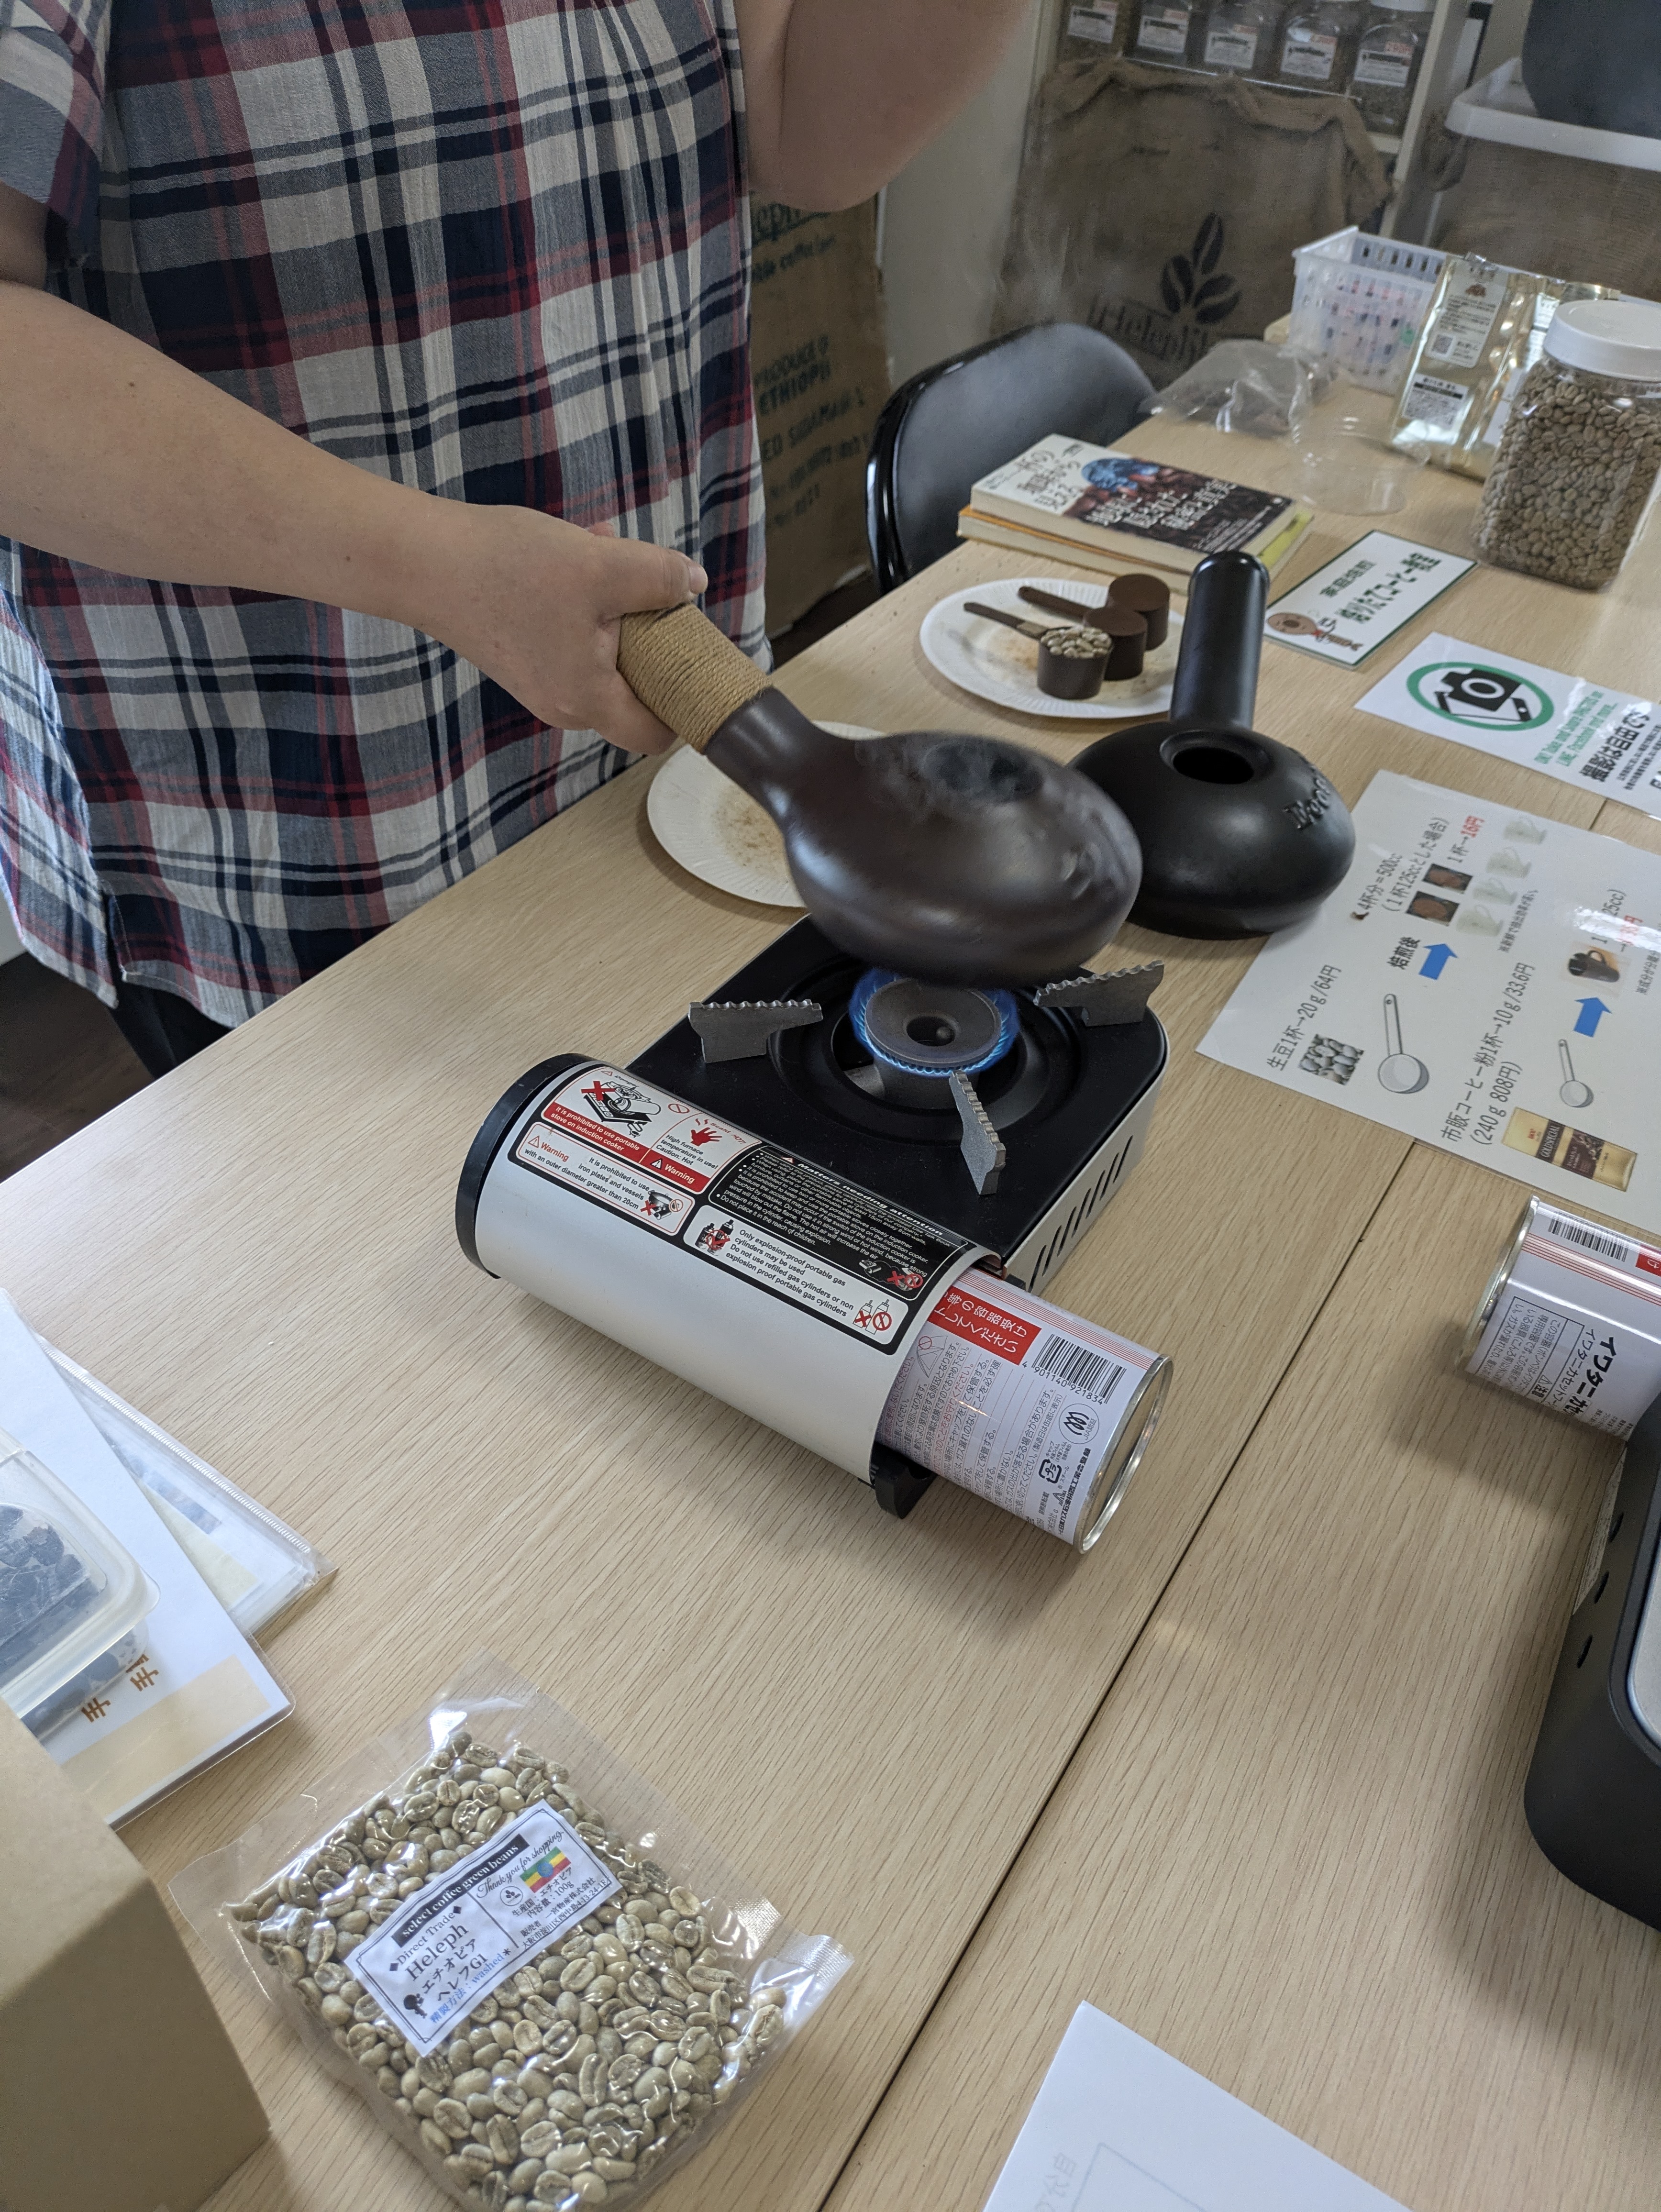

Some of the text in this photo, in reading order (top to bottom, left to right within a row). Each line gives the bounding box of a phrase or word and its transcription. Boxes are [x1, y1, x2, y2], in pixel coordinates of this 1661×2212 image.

[1386, 933, 1421, 971] 焙煎後
[551, 1113, 624, 1150] stove on induction cooker
[566, 1113, 597, 1129] prohibited
[614, 1136, 639, 1150] portable
[665, 1134, 703, 1155] High furnace
[541, 1142, 569, 1162] Warning
[656, 1144, 693, 1165] Caution: Hot
[658, 1139, 696, 1159] temperature
[703, 1161, 719, 1169] use!
[525, 1149, 537, 1158] with
[545, 1160, 561, 1170] outer
[561, 1167, 587, 1182] diameter
[586, 1181, 608, 1193] greater
[608, 1190, 622, 1201] than
[622, 1197, 639, 1209] 20cm
[578, 1163, 644, 1200] iron plates and vessels
[593, 1159, 603, 1167] is
[599, 1164, 631, 1181] prohibited
[638, 1183, 649, 1191] use
[664, 1164, 695, 1183] Warning
[797, 1163, 942, 1235] Matters needing attention
[734, 1238, 806, 1275] cylinders may be used
[739, 1229, 847, 1288] Only explosion-proof portable gas
[726, 1252, 846, 1316] explosion proof portable gas cylinders
[730, 1243, 740, 1252] Do
[740, 1250, 752, 1259] not
[752, 1256, 764, 1264] use
[764, 1262, 788, 1276] refilled
[786, 1272, 801, 1284] gas
[801, 1281, 830, 1298] cylinders
[840, 1300, 853, 1310] non
[1034, 1365, 1067, 1387] 901140
[1070, 1382, 1103, 1405] 921834
[1577, 1337, 1616, 1397] イワタニ
[1530, 1382, 1549, 1400] 注意
[476, 1831, 564, 1898] Thank you for shopping.
[402, 1846, 518, 1936] select coffee green beans
[396, 1912, 455, 1965] Direct Trade
[520, 1920, 541, 1937] 販売者
[406, 1925, 468, 1980] Heleph
[422, 1938, 475, 1993] エチオピア
